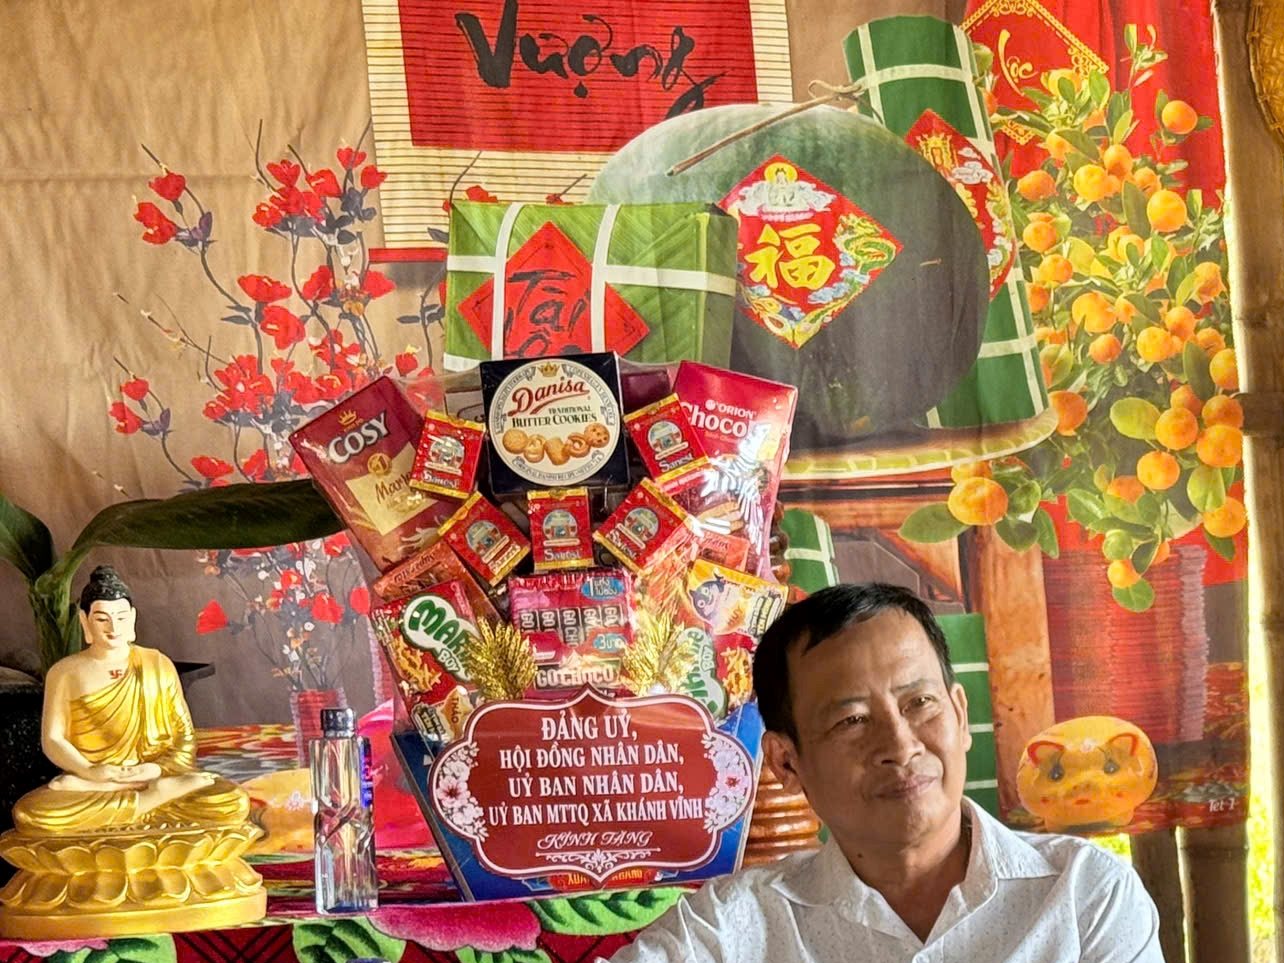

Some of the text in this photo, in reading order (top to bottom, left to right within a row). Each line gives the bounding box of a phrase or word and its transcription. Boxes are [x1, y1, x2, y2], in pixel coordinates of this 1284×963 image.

[744, 222, 835, 291] 福
[508, 376, 591, 417] Danisa
[717, 402, 754, 419] ORION
[512, 413, 598, 428] BUTTER COOKIES
[328, 410, 390, 464] COSY
[438, 648, 461, 672] BOY
[541, 710, 599, 741] ĐẢNG
[500, 739, 685, 773] HỘI ĐỒNG NHÂN DÂN,
[508, 768, 684, 798] UỶ BAN NHÂN DÂN,
[488, 796, 704, 827] UỶ BAN MTTQ XÃ KHÁNH VĨNH
